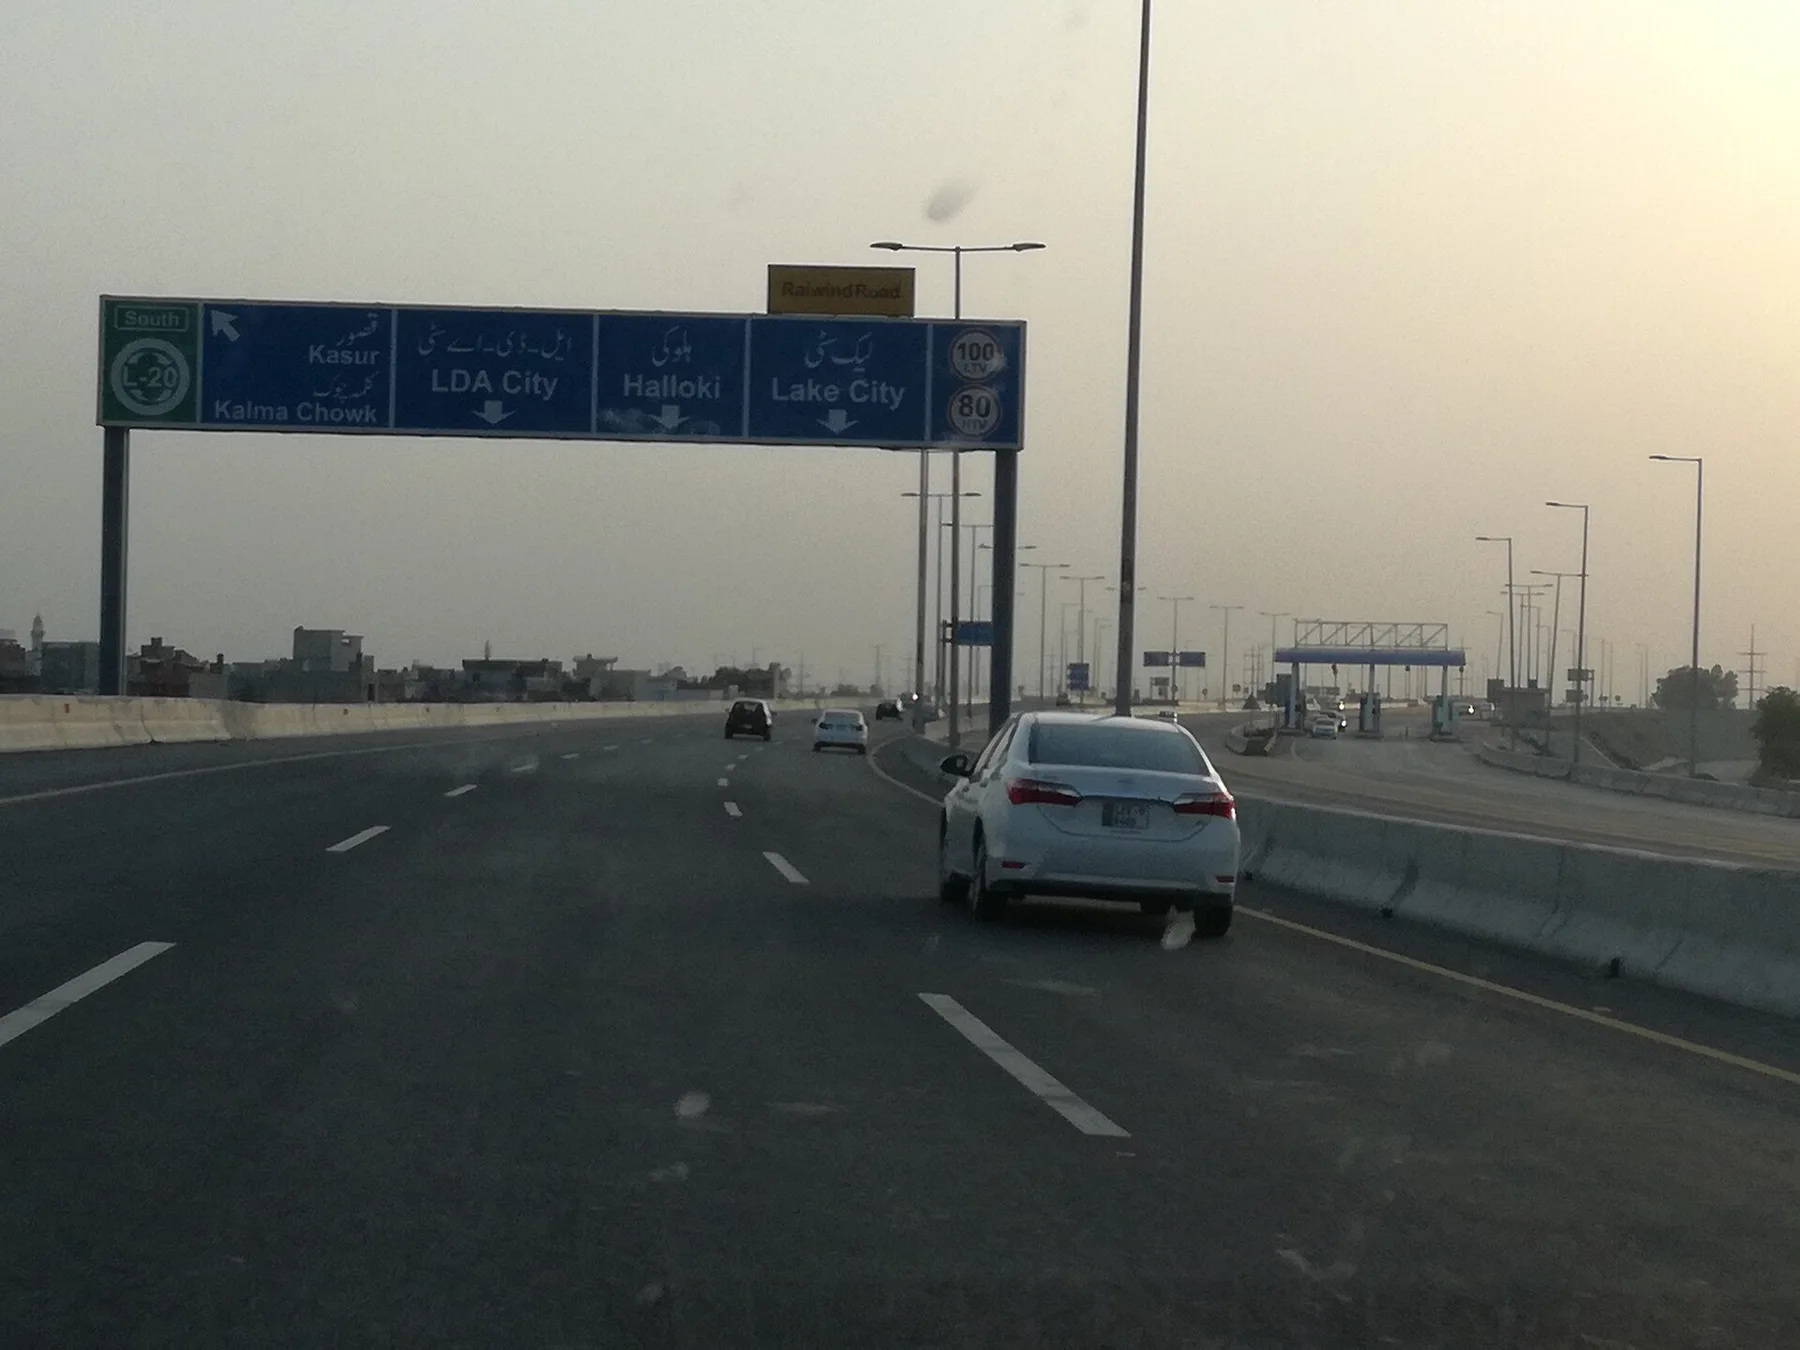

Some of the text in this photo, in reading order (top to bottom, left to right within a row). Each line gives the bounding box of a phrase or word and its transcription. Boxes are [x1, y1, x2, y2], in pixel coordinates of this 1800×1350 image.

[781, 281, 901, 299] Raiwind Road
[124, 310, 180, 328] South
[308, 344, 380, 365] Kasur
[957, 342, 994, 361] 100
[123, 365, 178, 388] L-20
[431, 368, 559, 401] LDA City
[623, 373, 721, 399] Halloki
[771, 376, 908, 412] Lake City
[214, 399, 377, 423] Kalma Chowk
[958, 394, 991, 418] 80
